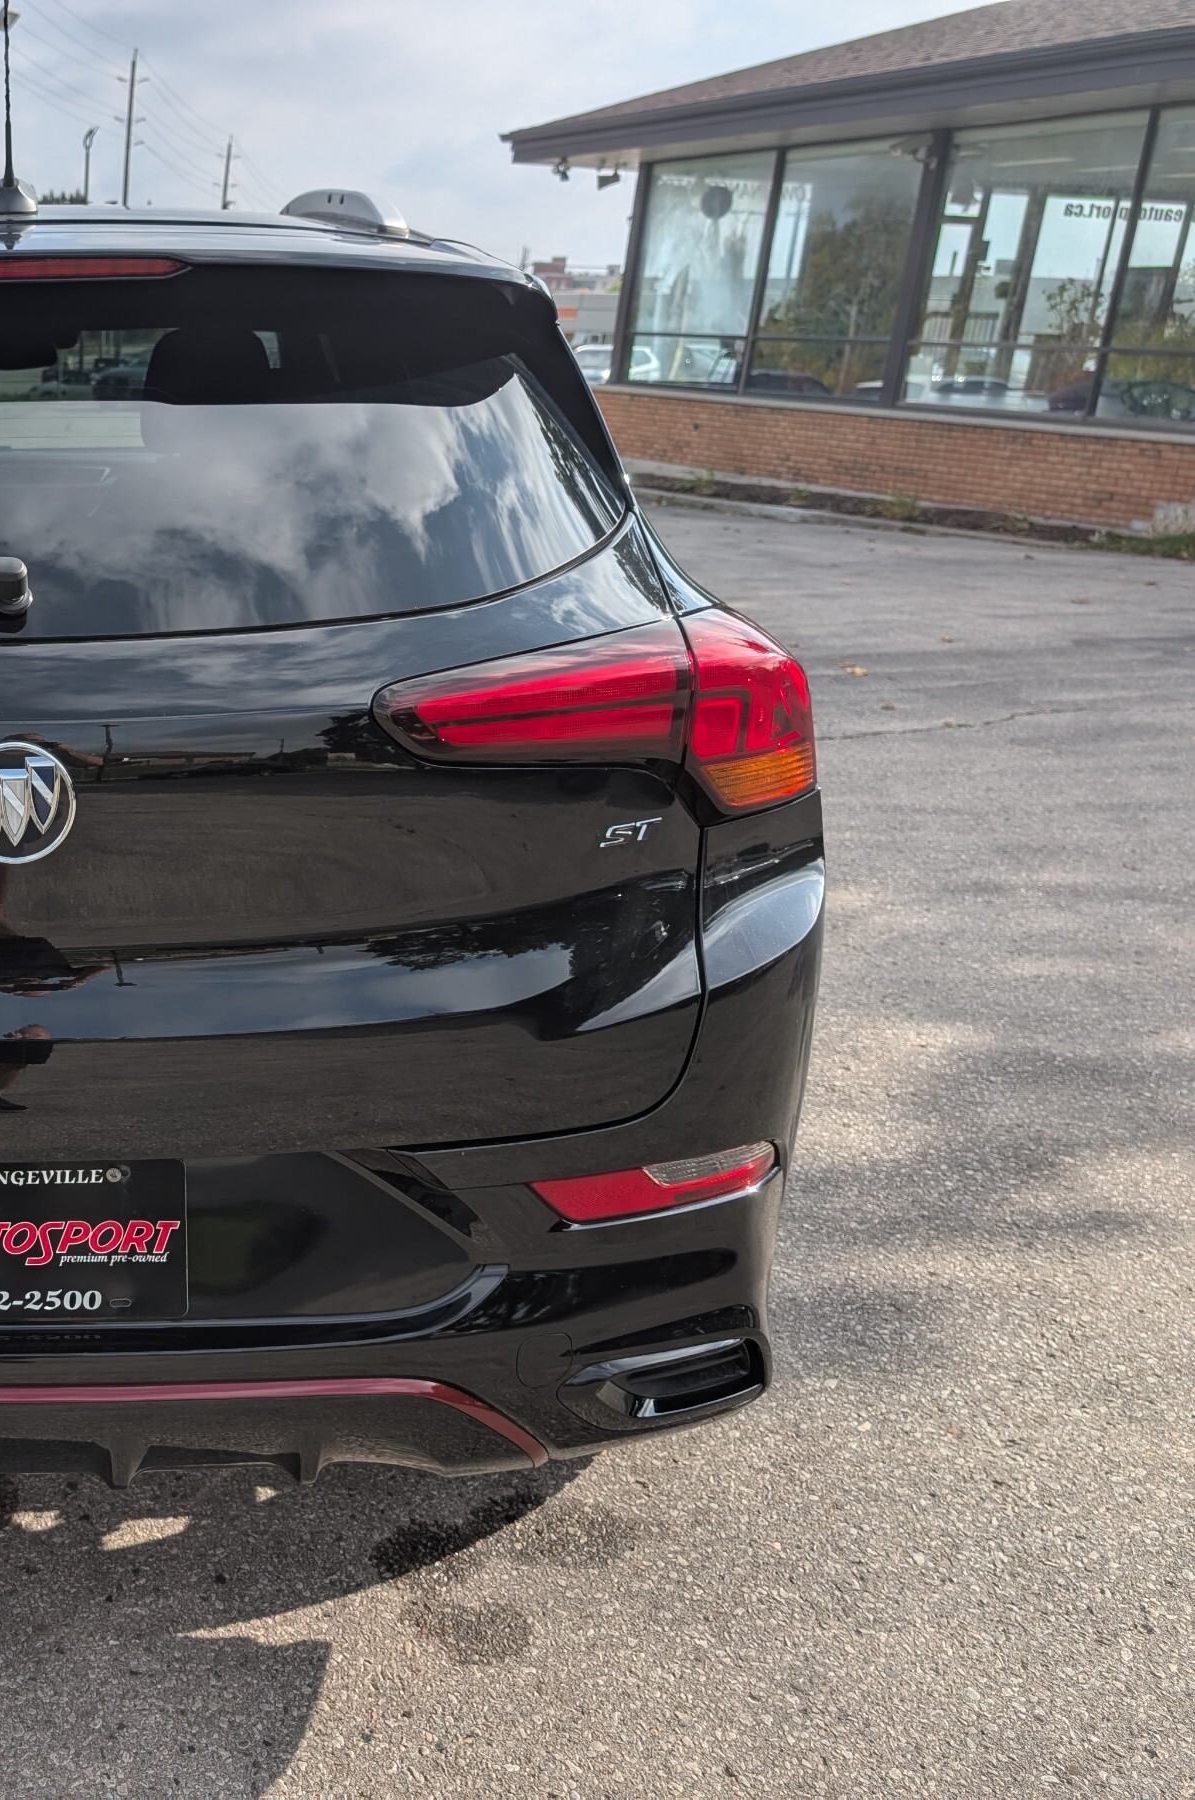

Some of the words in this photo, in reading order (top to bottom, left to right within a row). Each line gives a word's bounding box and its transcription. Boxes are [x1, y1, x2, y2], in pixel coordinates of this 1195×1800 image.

[600, 817, 662, 848] ST
[59, 1252, 109, 1266] premium
[109, 1251, 169, 1266] pre-owned
